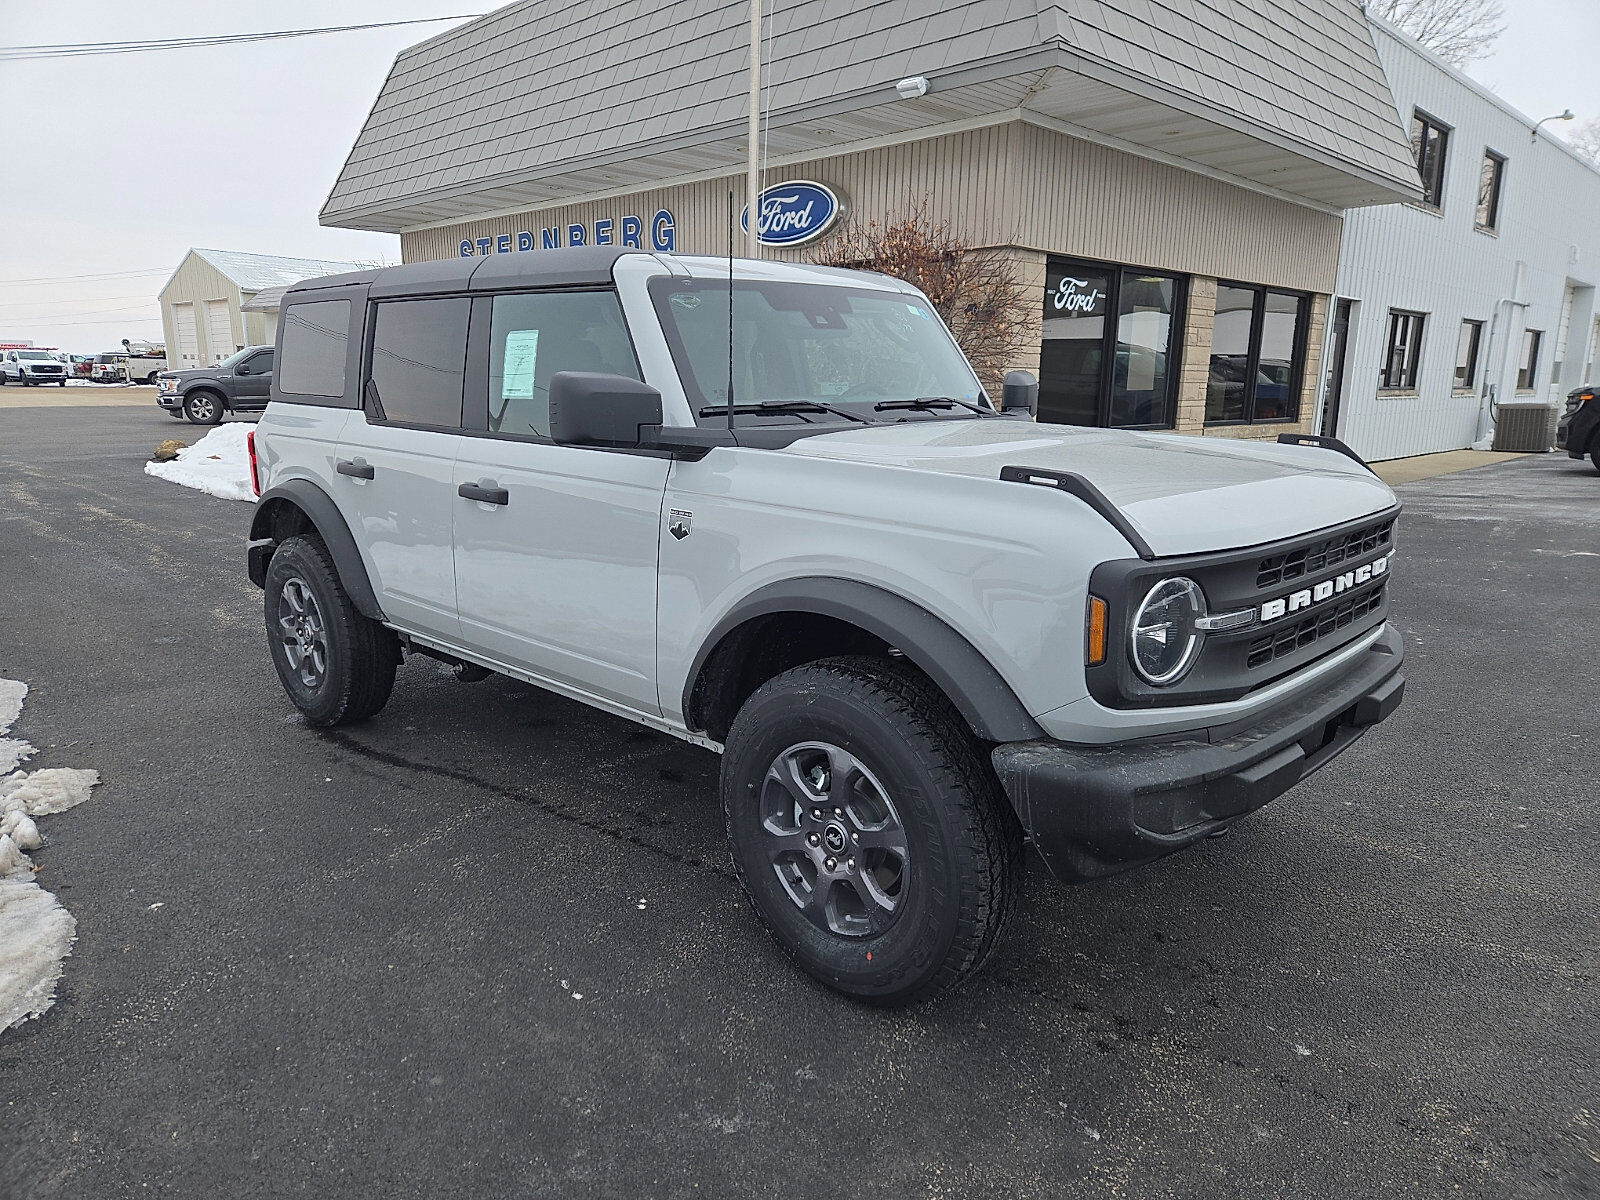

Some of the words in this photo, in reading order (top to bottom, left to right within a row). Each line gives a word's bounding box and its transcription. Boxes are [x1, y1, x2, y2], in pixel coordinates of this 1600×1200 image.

[459, 209, 675, 258] STERNBERG
[757, 194, 814, 234] Ford
[1054, 277, 1098, 312] Ford
[1261, 557, 1387, 621] BRONCO
